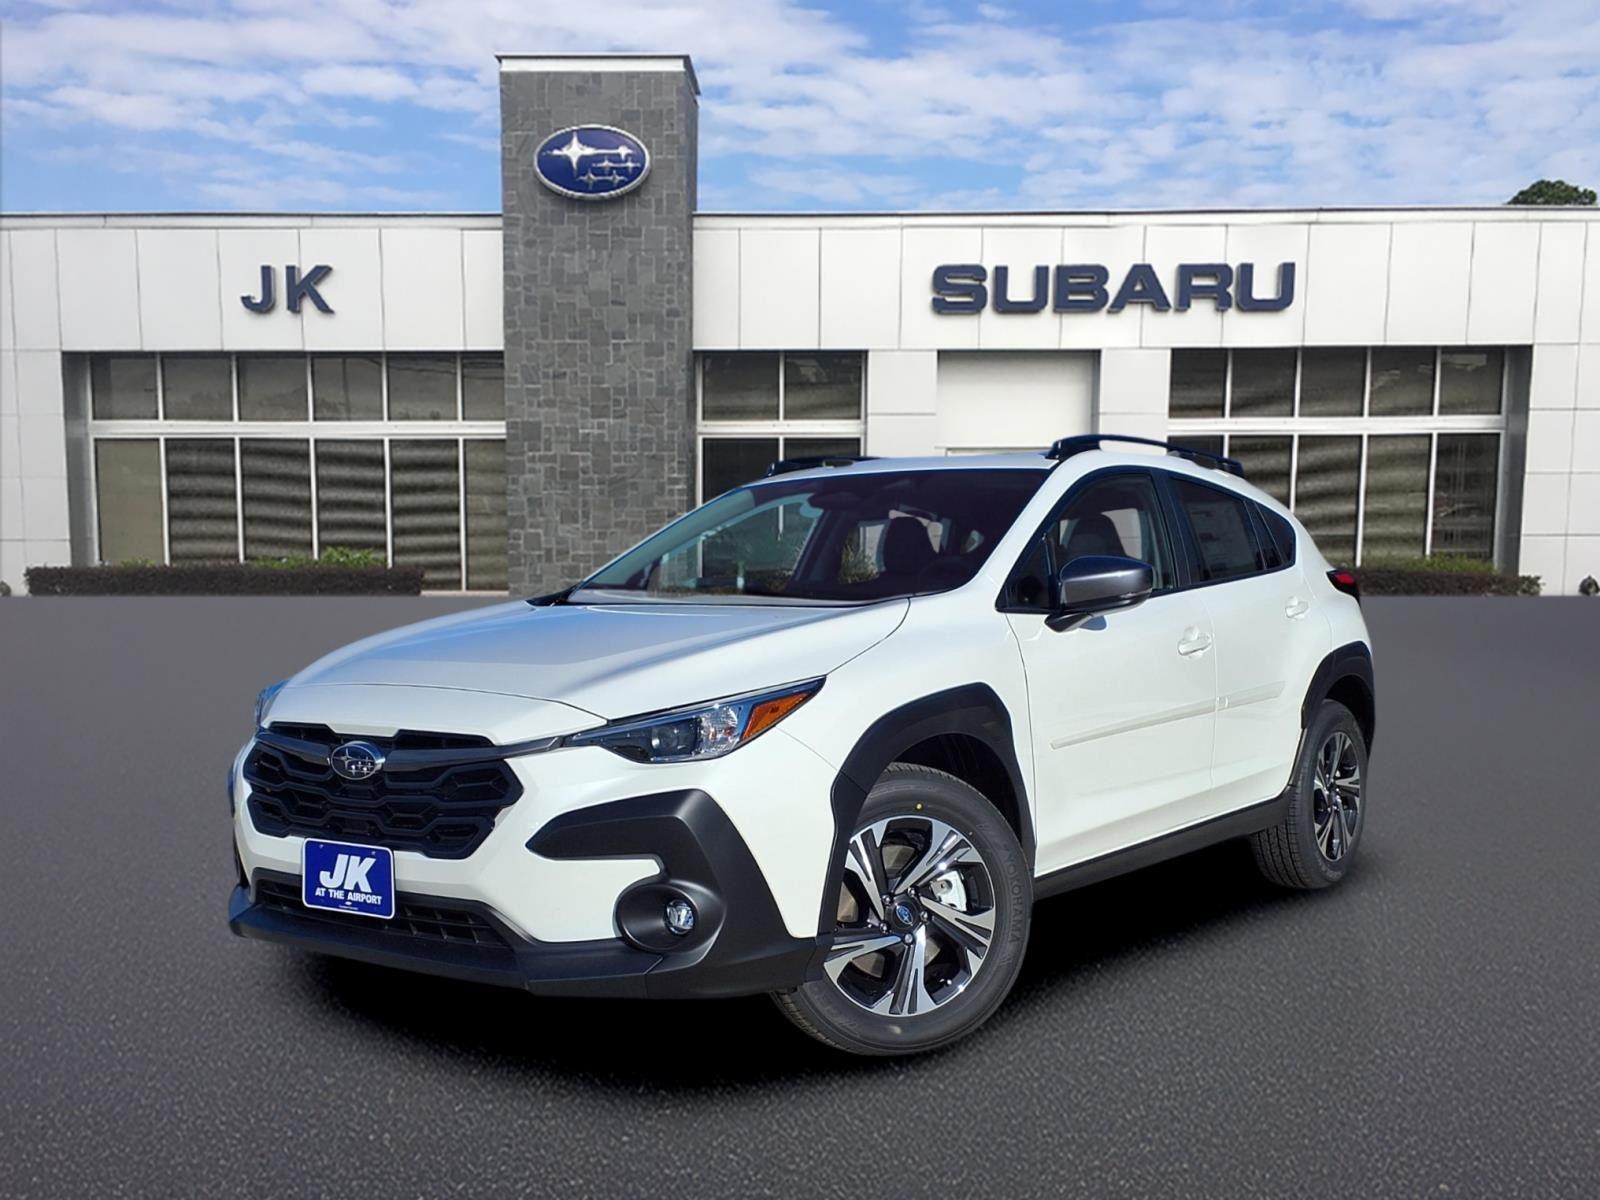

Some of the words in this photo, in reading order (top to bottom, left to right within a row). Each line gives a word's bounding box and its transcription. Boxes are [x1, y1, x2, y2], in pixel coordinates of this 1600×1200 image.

[241, 265, 335, 314] JK
[932, 262, 1295, 314] SUBARU
[315, 887, 325, 896] AT
[328, 889, 344, 899] THE
[347, 892, 382, 905] AIRPORT
[319, 854, 376, 893] JK
[1002, 852, 1024, 943] YOKOHAMA
